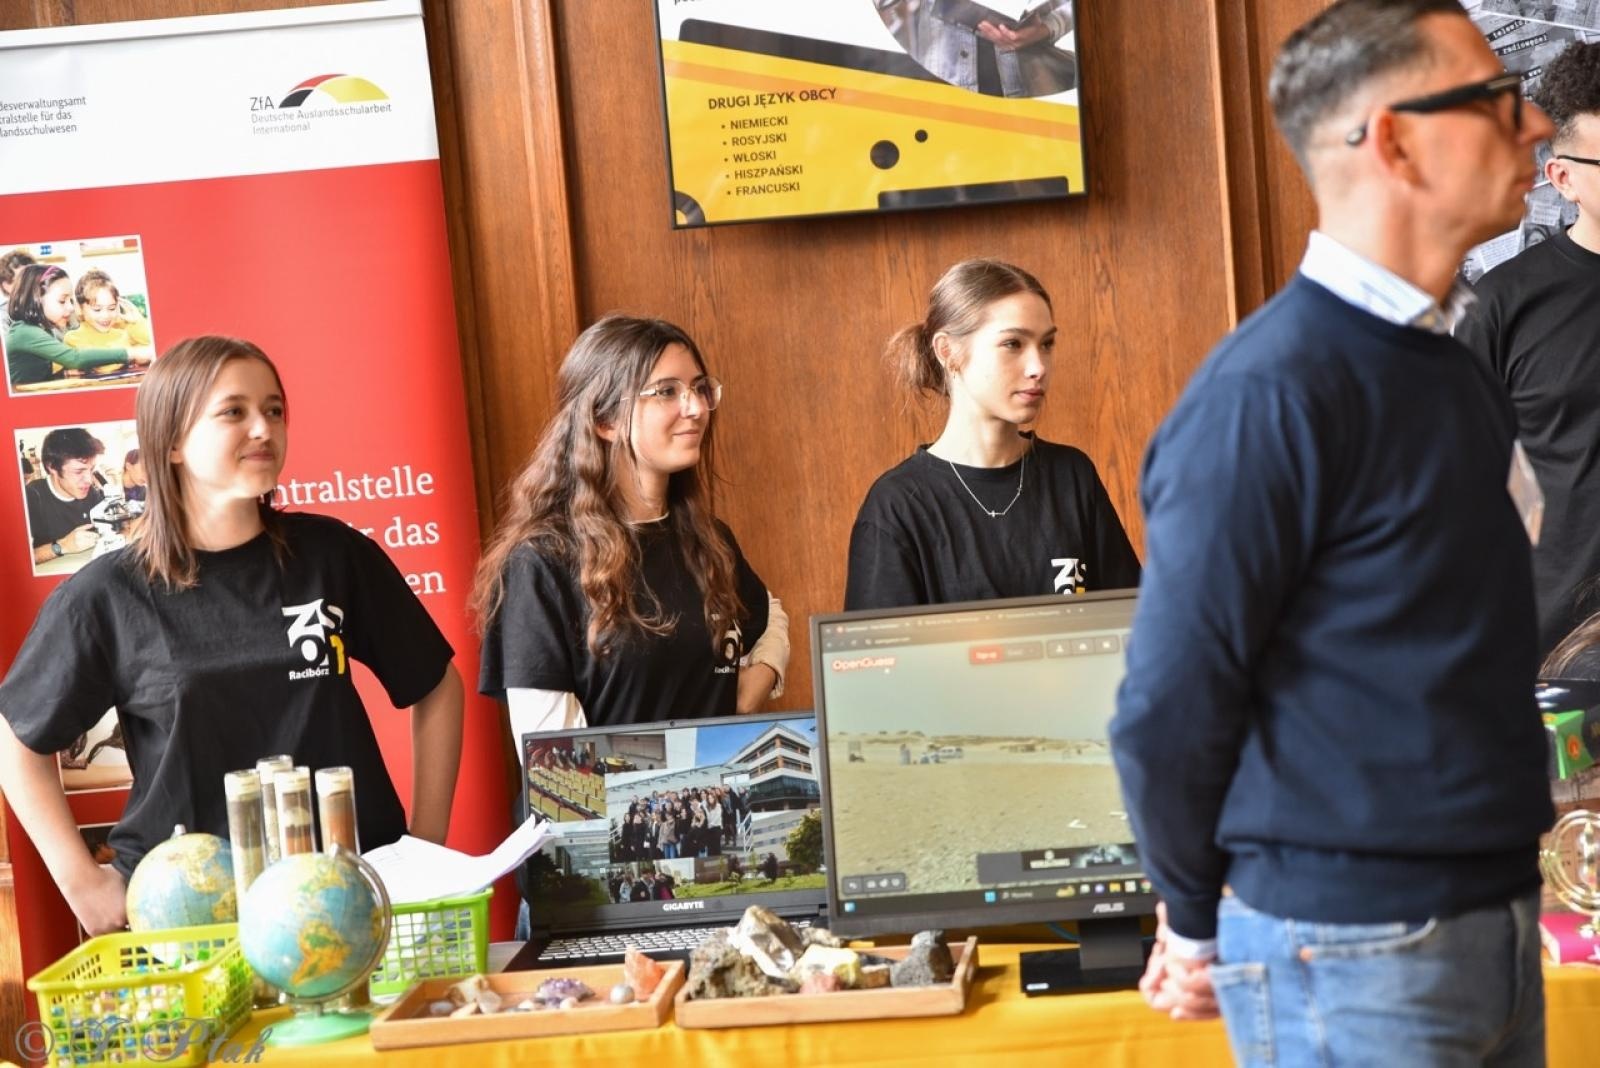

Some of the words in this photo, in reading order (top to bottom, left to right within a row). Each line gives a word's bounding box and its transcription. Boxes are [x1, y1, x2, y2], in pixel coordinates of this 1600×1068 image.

[250, 95, 275, 111] ZfA
[708, 96, 750, 110] DRUGI
[753, 91, 796, 108] JĘZYK
[799, 88, 837, 102] OBCY
[40, 110, 54, 121] für
[56, 109, 72, 120] das
[251, 110, 295, 124] Deutsche
[297, 103, 392, 119] Auslandsschularbeit
[252, 122, 311, 135] International
[730, 115, 788, 130] NIEMIECKI
[731, 132, 787, 146] ROSYJSKI
[733, 150, 777, 163] WŁOSKI
[734, 164, 803, 180] HISZPAŃSKI
[735, 182, 801, 196] FRANCUSKI
[270, 465, 434, 506] ntralstelle
[384, 516, 440, 548] das
[289, 667, 330, 681] Racibórz
[662, 900, 705, 912] GIGABYTE
[1092, 902, 1125, 913] ASUS
